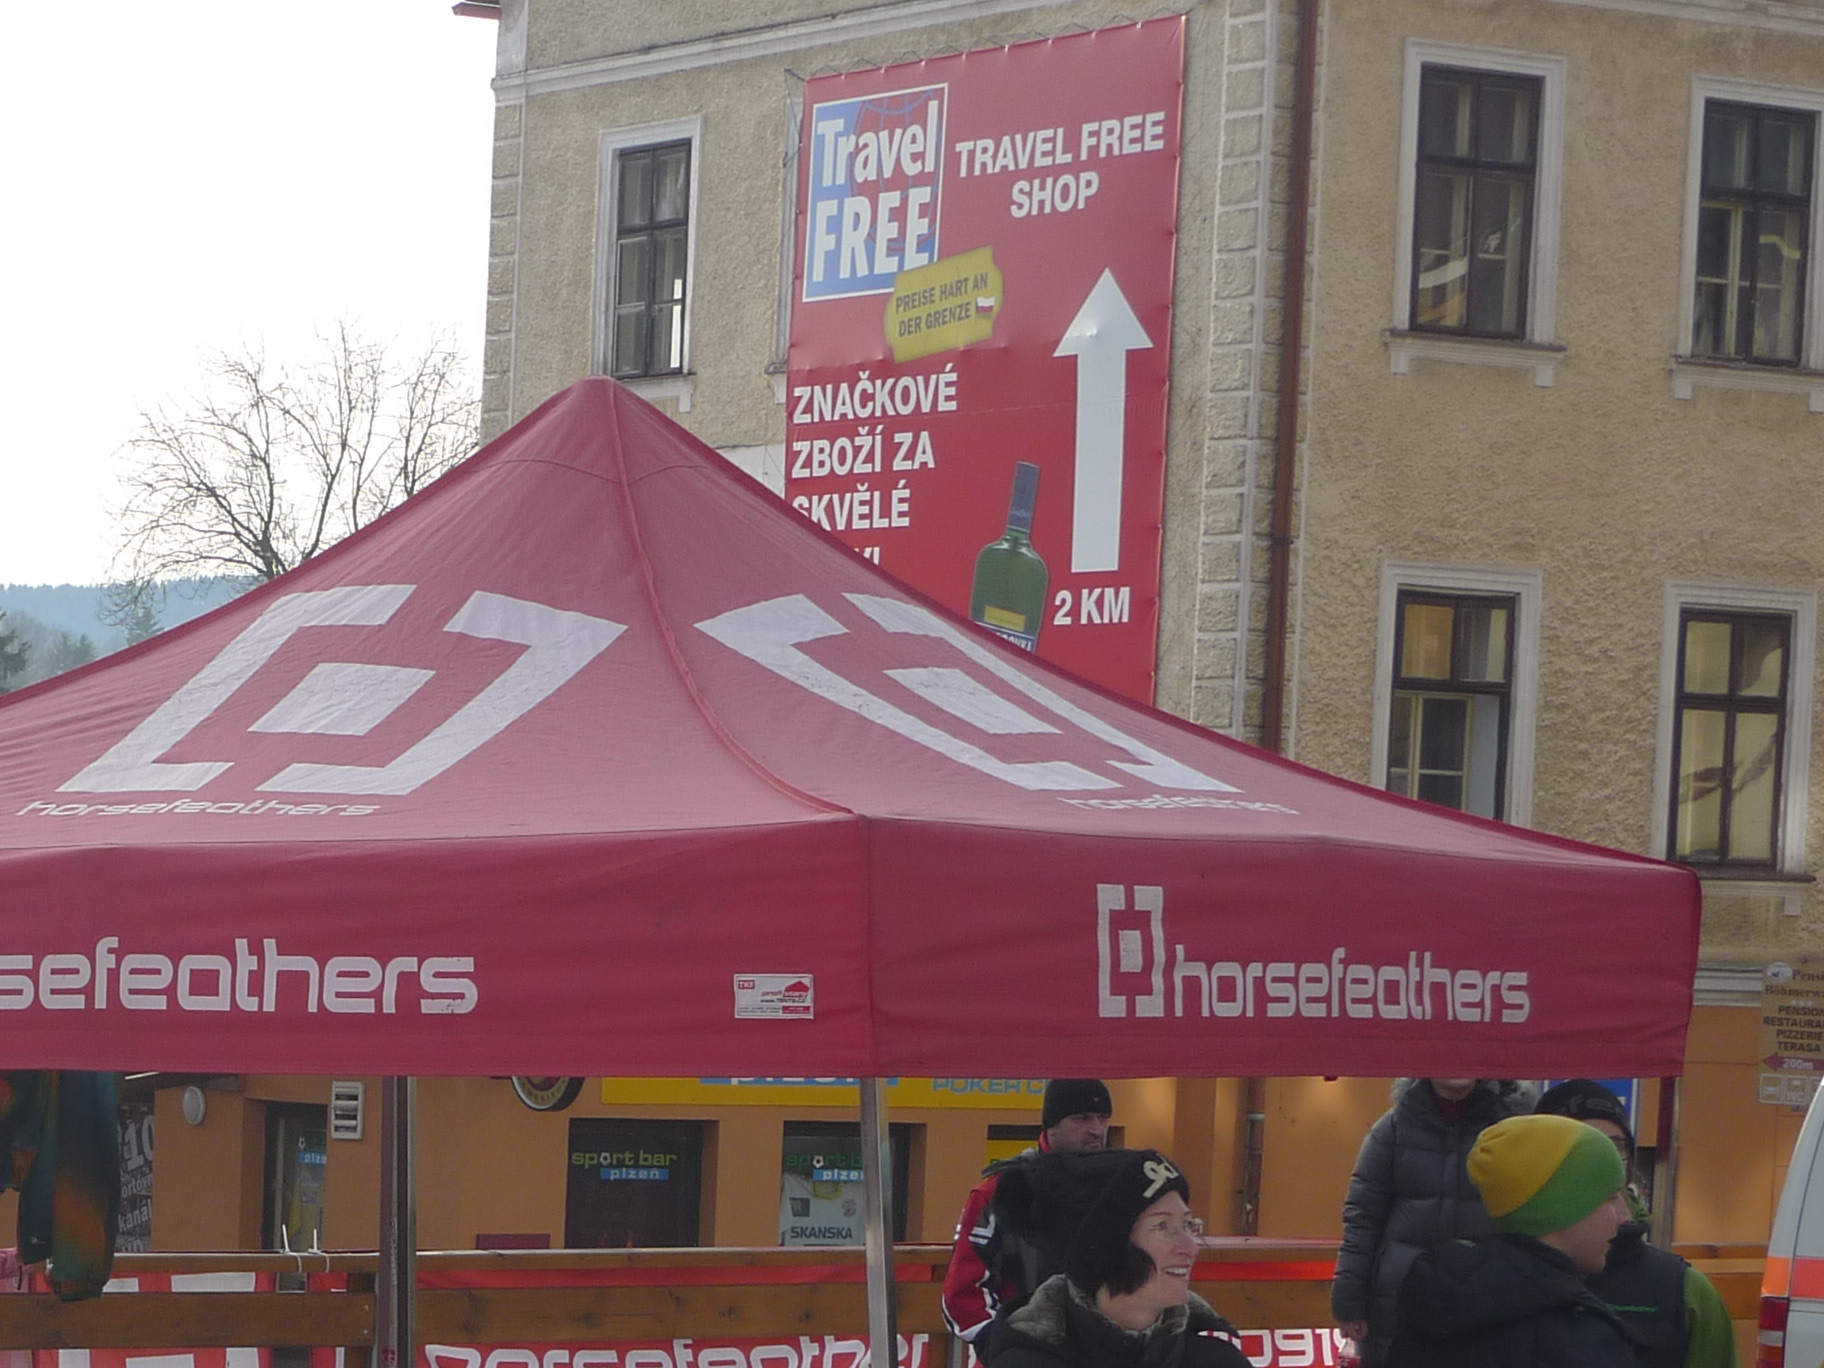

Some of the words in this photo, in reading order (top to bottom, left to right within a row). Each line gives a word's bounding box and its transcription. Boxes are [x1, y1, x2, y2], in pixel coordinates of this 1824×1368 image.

[816, 100, 940, 188] Travel
[955, 127, 1072, 178] TRAVEL
[1080, 111, 1165, 160] FREE
[1010, 171, 1100, 219] SHOP
[812, 186, 932, 283] FREE
[895, 286, 936, 314] PREISE
[939, 276, 969, 298] HART
[972, 272, 989, 290] AN
[898, 316, 923, 338] DER
[924, 304, 972, 332] GRENZE
[793, 363, 958, 424] ZNAČKOVÉ
[791, 425, 884, 478] ZBOŽÍ
[892, 431, 935, 470] ZA
[1053, 590, 1072, 625] 2
[1080, 586, 1131, 625] KM
[1176, 944, 1530, 1025] horsefeathers
[1777, 1040, 1821, 1053] TERASA
[933, 1078, 1024, 1094] POKER
[571, 1151, 635, 1169] sport
[639, 1149, 678, 1166] bar
[790, 1225, 854, 1240] SKANSKA
